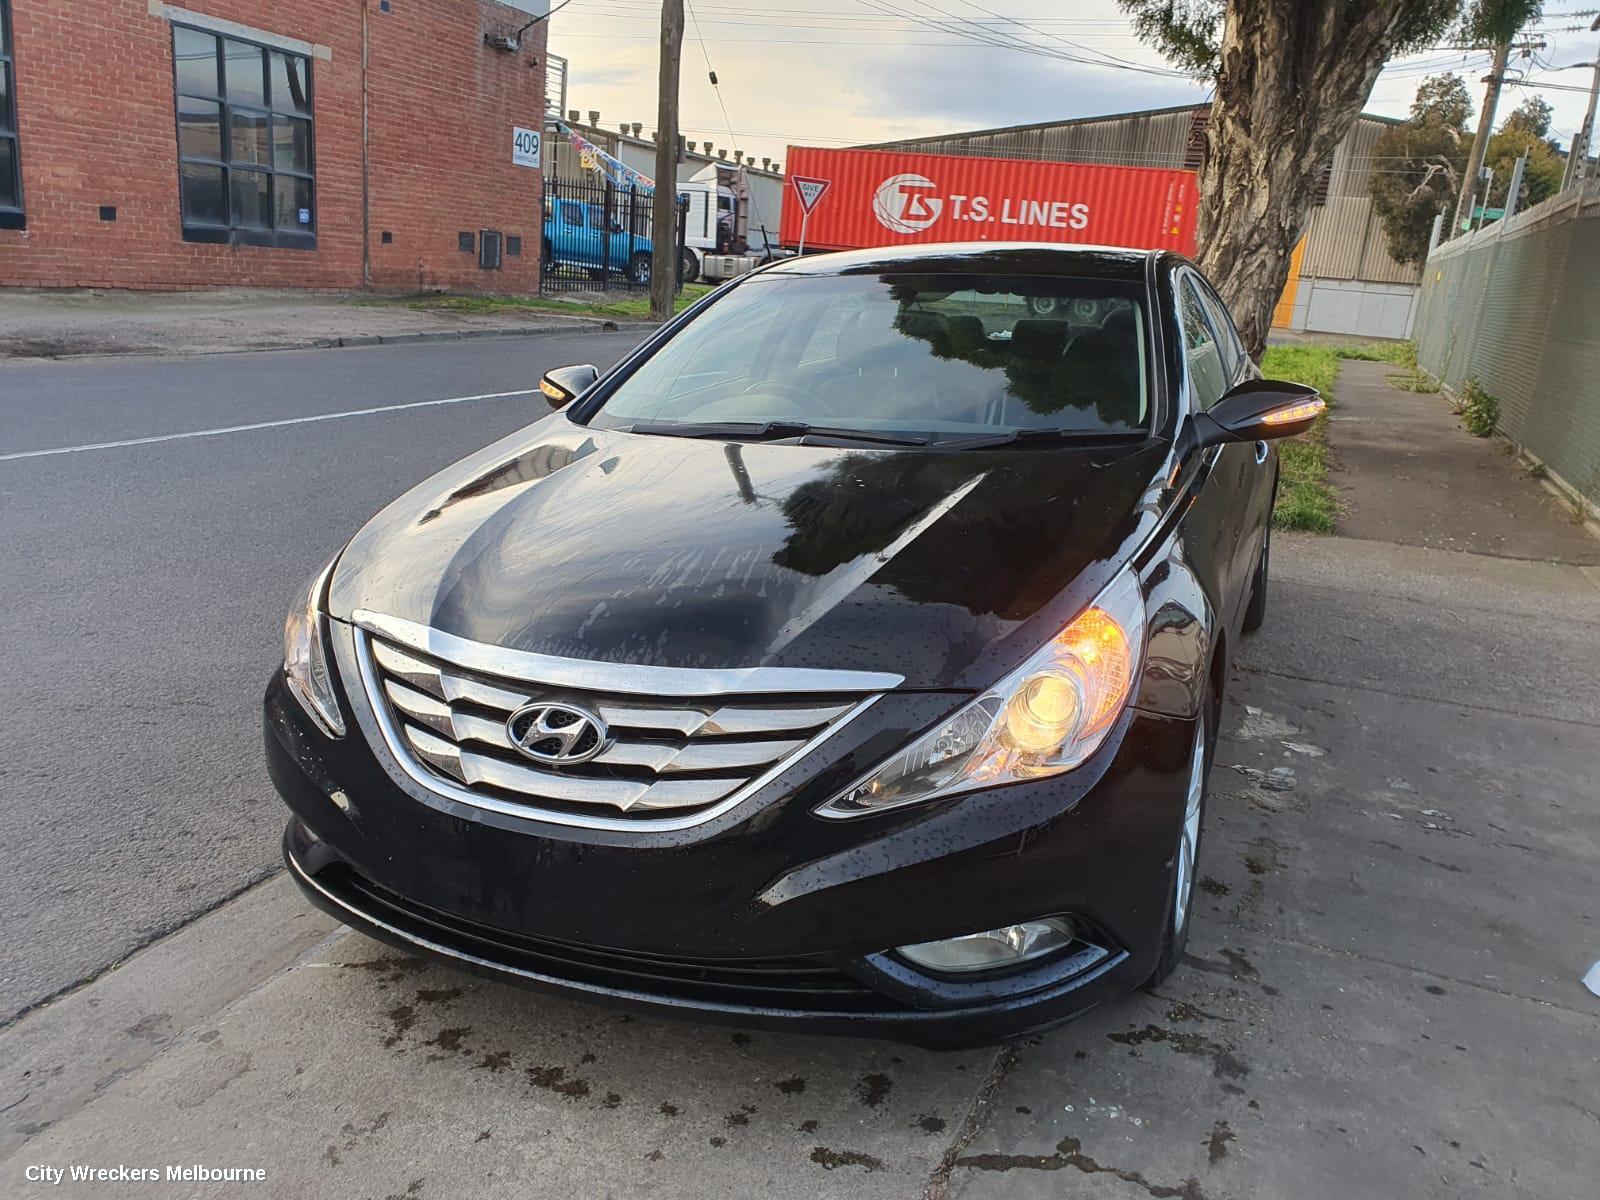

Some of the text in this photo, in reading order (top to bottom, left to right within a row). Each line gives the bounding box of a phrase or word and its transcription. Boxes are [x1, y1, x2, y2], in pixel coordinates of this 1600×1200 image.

[514, 131, 539, 155] 409
[802, 183, 820, 192] GIVE
[949, 194, 1090, 230] T.S. LINES
